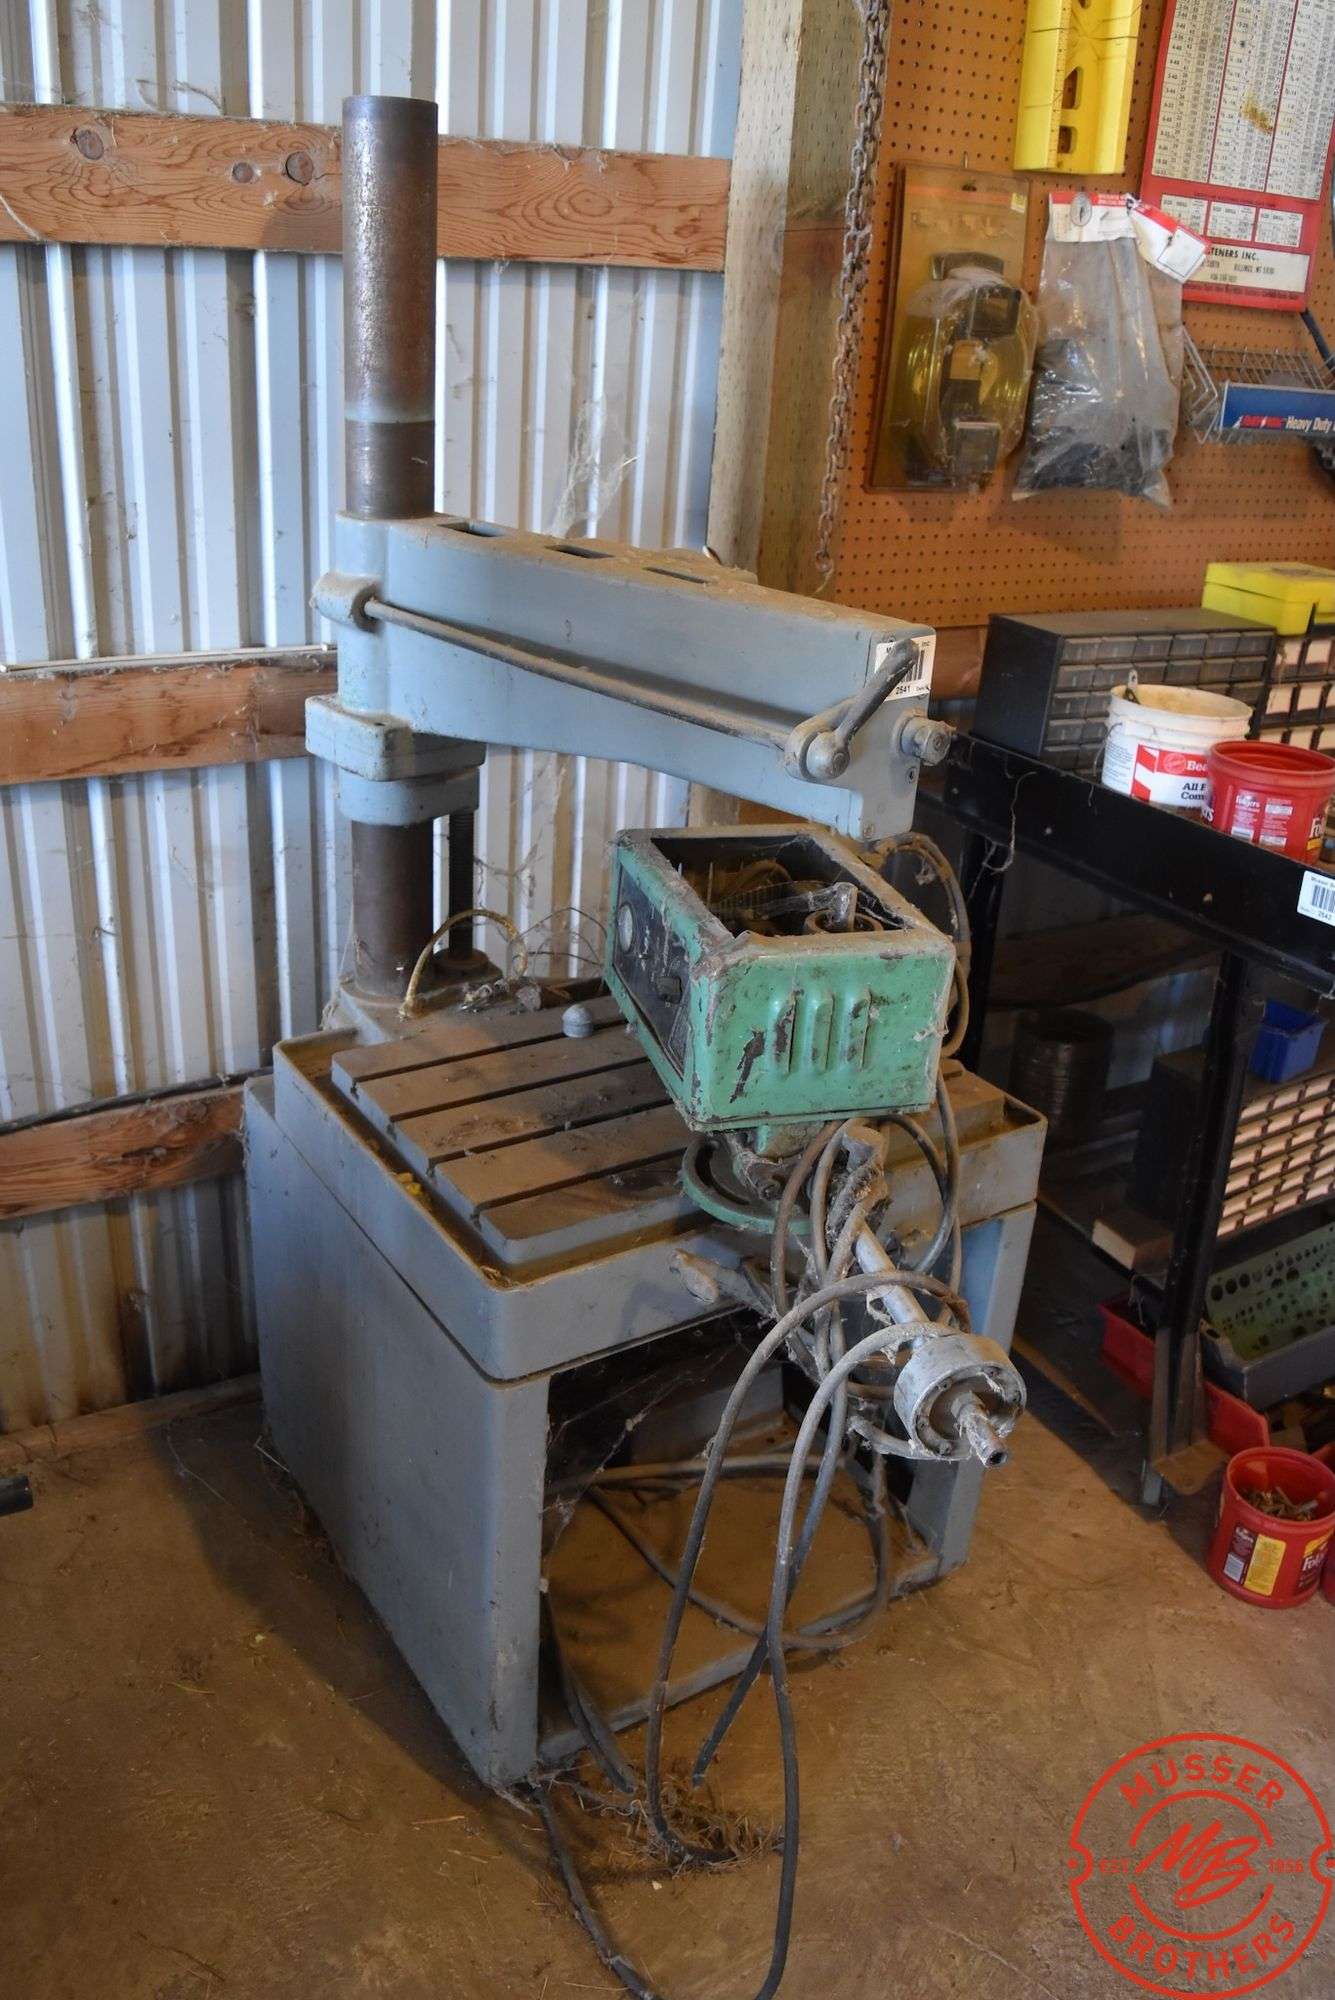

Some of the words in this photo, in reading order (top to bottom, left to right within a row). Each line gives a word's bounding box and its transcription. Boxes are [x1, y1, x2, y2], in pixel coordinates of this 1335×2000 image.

[1208, 247, 1239, 259] TENERS
[1285, 416, 1312, 433] Heavy
[1182, 782, 1199, 791] All
